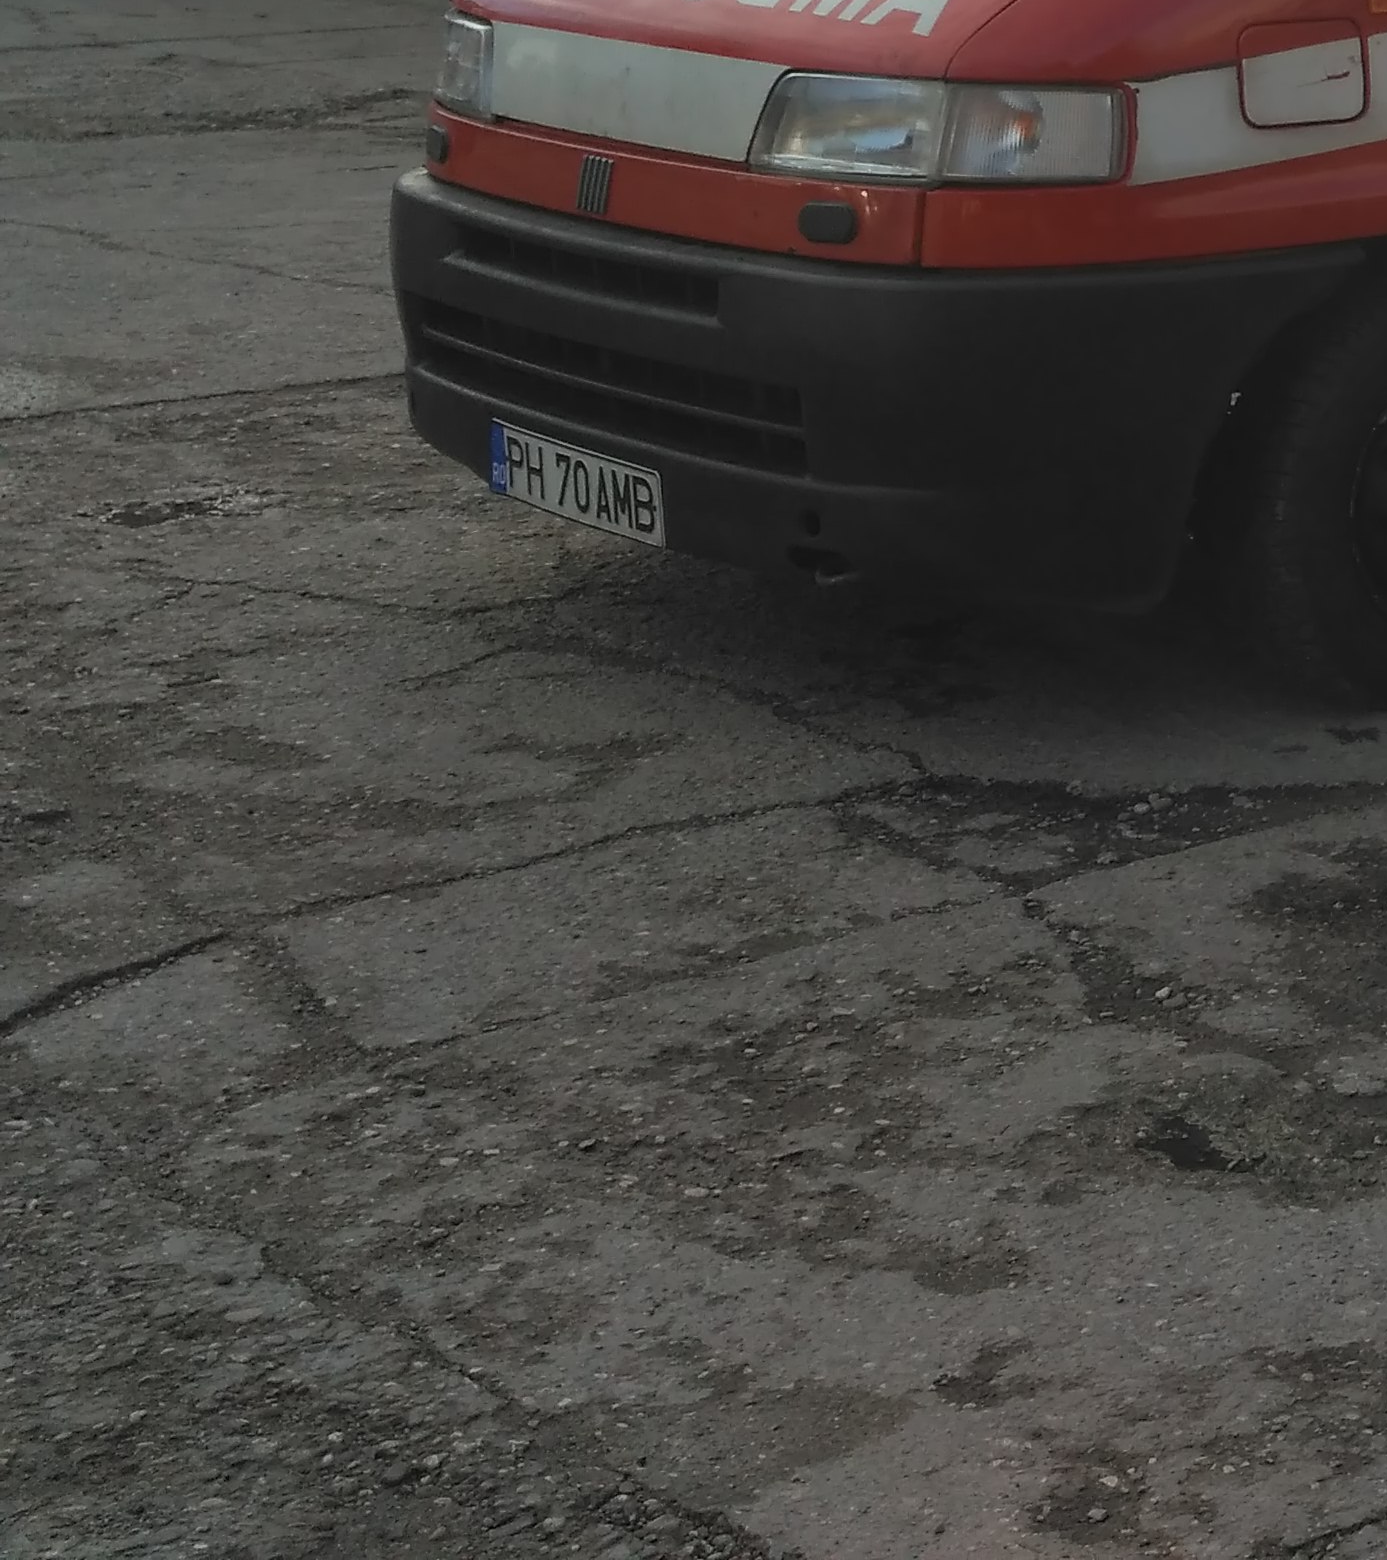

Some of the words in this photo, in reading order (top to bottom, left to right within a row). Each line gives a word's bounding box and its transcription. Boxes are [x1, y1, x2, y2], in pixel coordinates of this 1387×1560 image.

[506, 435, 546, 500] PH
[555, 451, 591, 515] 70
[596, 465, 656, 534] AMB
